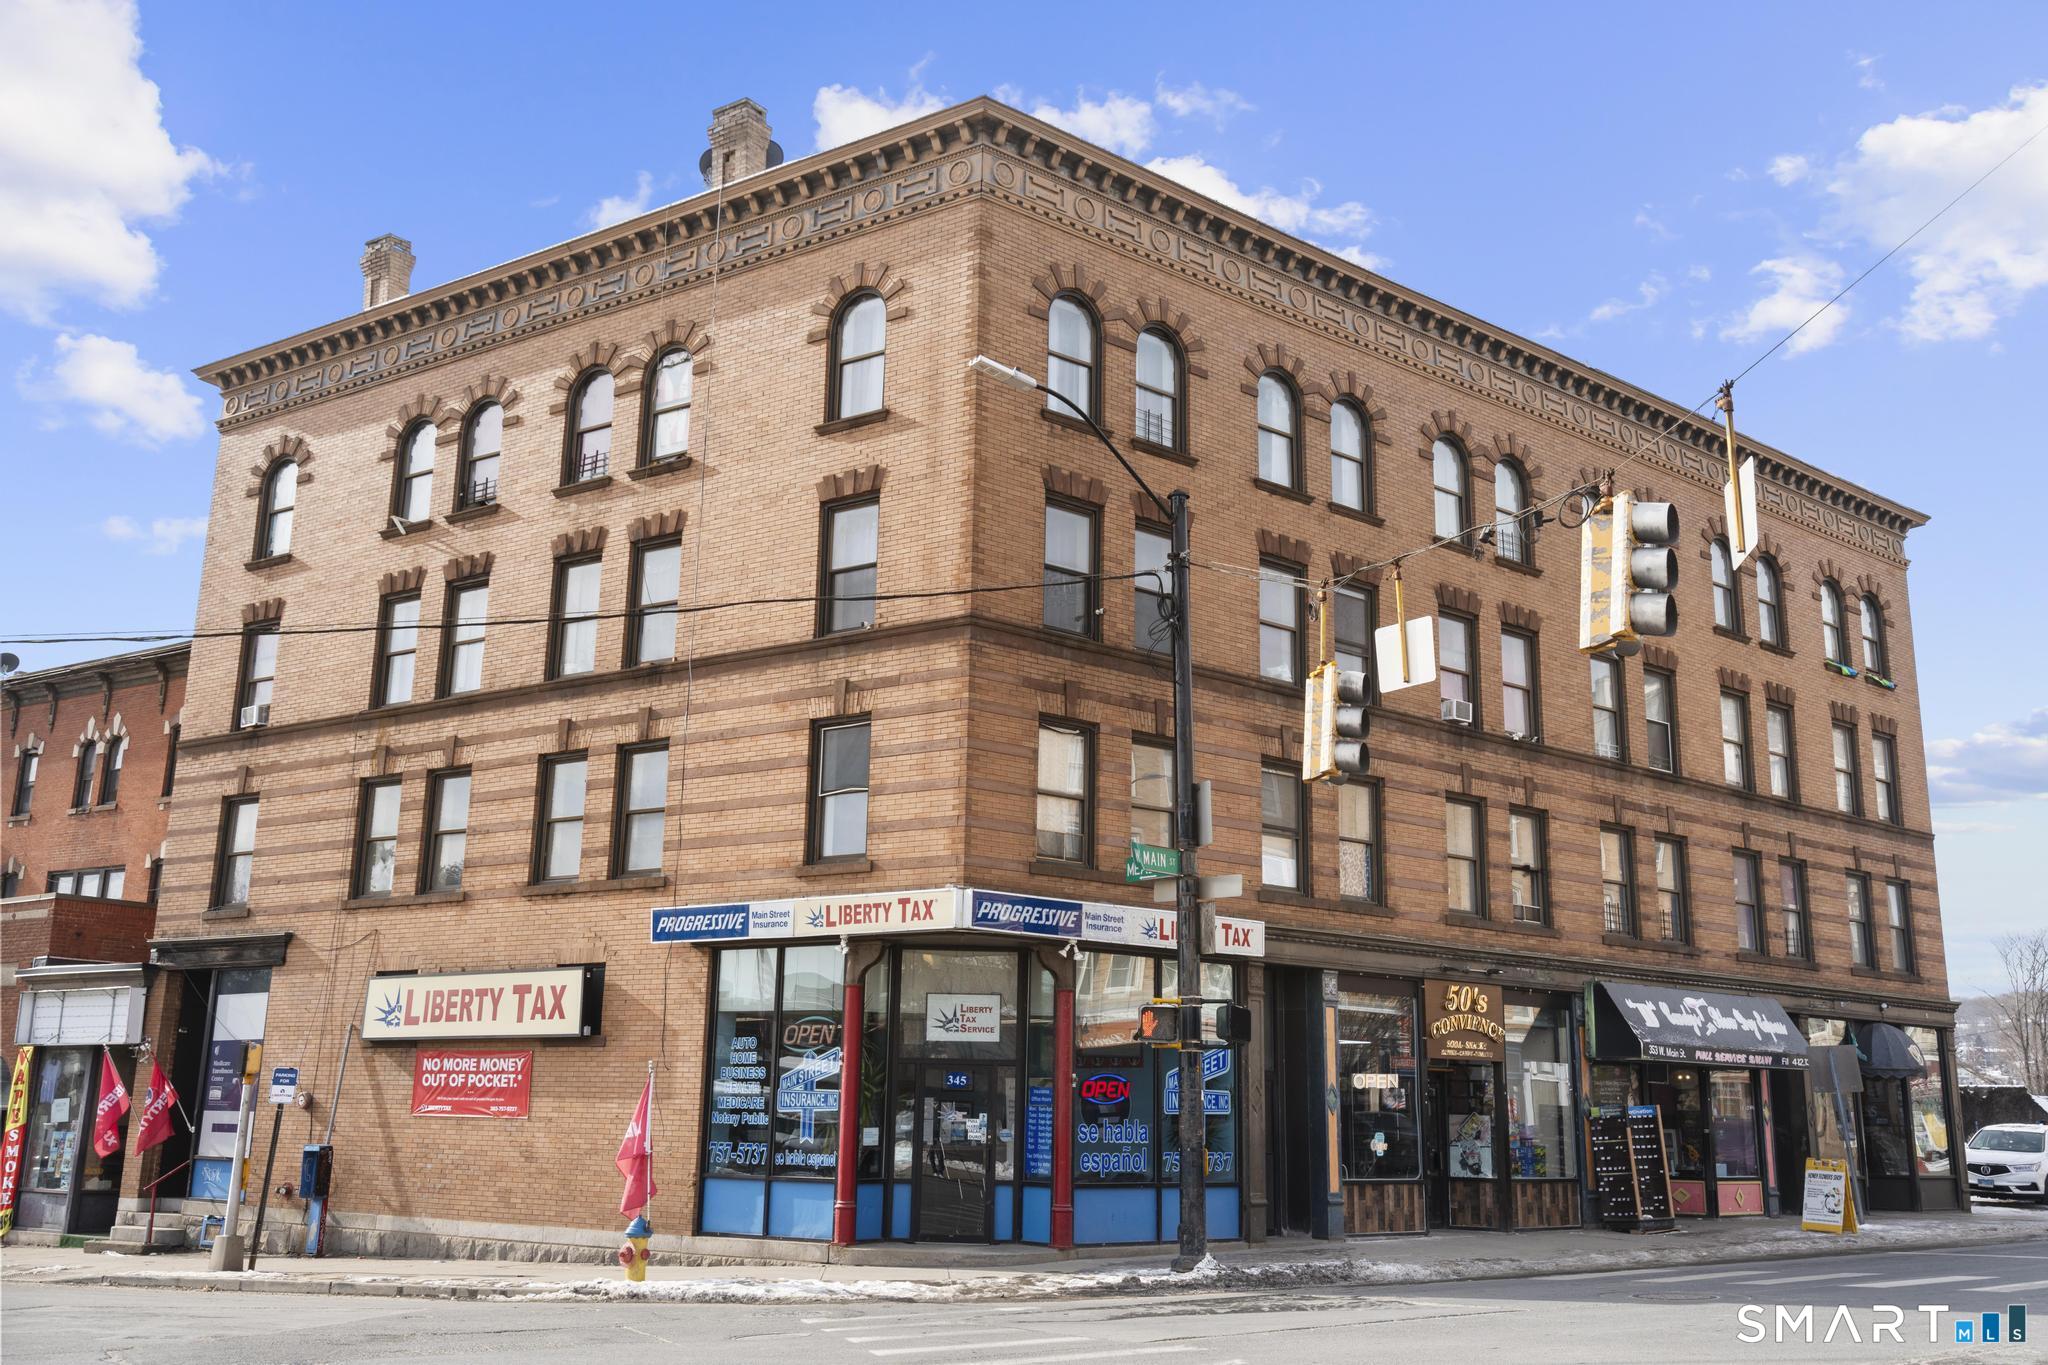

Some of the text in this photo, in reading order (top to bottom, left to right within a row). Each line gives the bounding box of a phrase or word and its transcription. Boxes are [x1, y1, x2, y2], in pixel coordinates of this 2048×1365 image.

[1143, 850, 1166, 868] MAIN
[751, 909, 791, 919] Main Street
[825, 897, 934, 928] LIBERTY TAX
[977, 901, 1081, 928] PROGRESSIVE
[1085, 911, 1124, 925] Main Street
[656, 912, 746, 933] PROGRESSIVE
[752, 920, 789, 929] Insurance
[1086, 921, 1123, 933] Insurance
[1221, 923, 1251, 947] TAX
[403, 984, 567, 1026] LIBERTY TAX
[1445, 985, 1488, 1013] 50's
[960, 1003, 993, 1013] LIBERTY
[960, 1015, 976, 1023] TAX
[783, 1024, 835, 1046] OPEN
[960, 1024, 995, 1033] SERVICE
[731, 1037, 757, 1049] AUTO
[730, 1052, 757, 1064] HOME
[1649, 1045, 1658, 1055] 353
[1666, 1048, 1679, 1058] Main
[1715, 1052, 1747, 1064] SERVICE
[422, 1058, 524, 1071] NO MORE MONEY
[782, 1055, 835, 1090] MAIN STREET
[1168, 1051, 1225, 1090] MA EET
[422, 1074, 445, 1087] OUT
[449, 1074, 465, 1086] OF
[720, 1067, 766, 1079] BUSINESS
[946, 1075, 967, 1086] 345
[1353, 1073, 1399, 1089] OPEN
[723, 1081, 762, 1094] HEALTH
[1081, 1080, 1131, 1099] OPEN
[717, 1096, 765, 1109] MEDICARE
[712, 1111, 769, 1127] Notary Public
[1078, 1122, 1099, 1143] se
[1103, 1118, 1149, 1143] habla
[709, 1142, 768, 1165] 757-5737
[775, 1152, 784, 1165] se
[785, 1149, 806, 1166] habla
[1080, 1146, 1147, 1177] español
[0, 1129, 20, 1205] SMOKE
